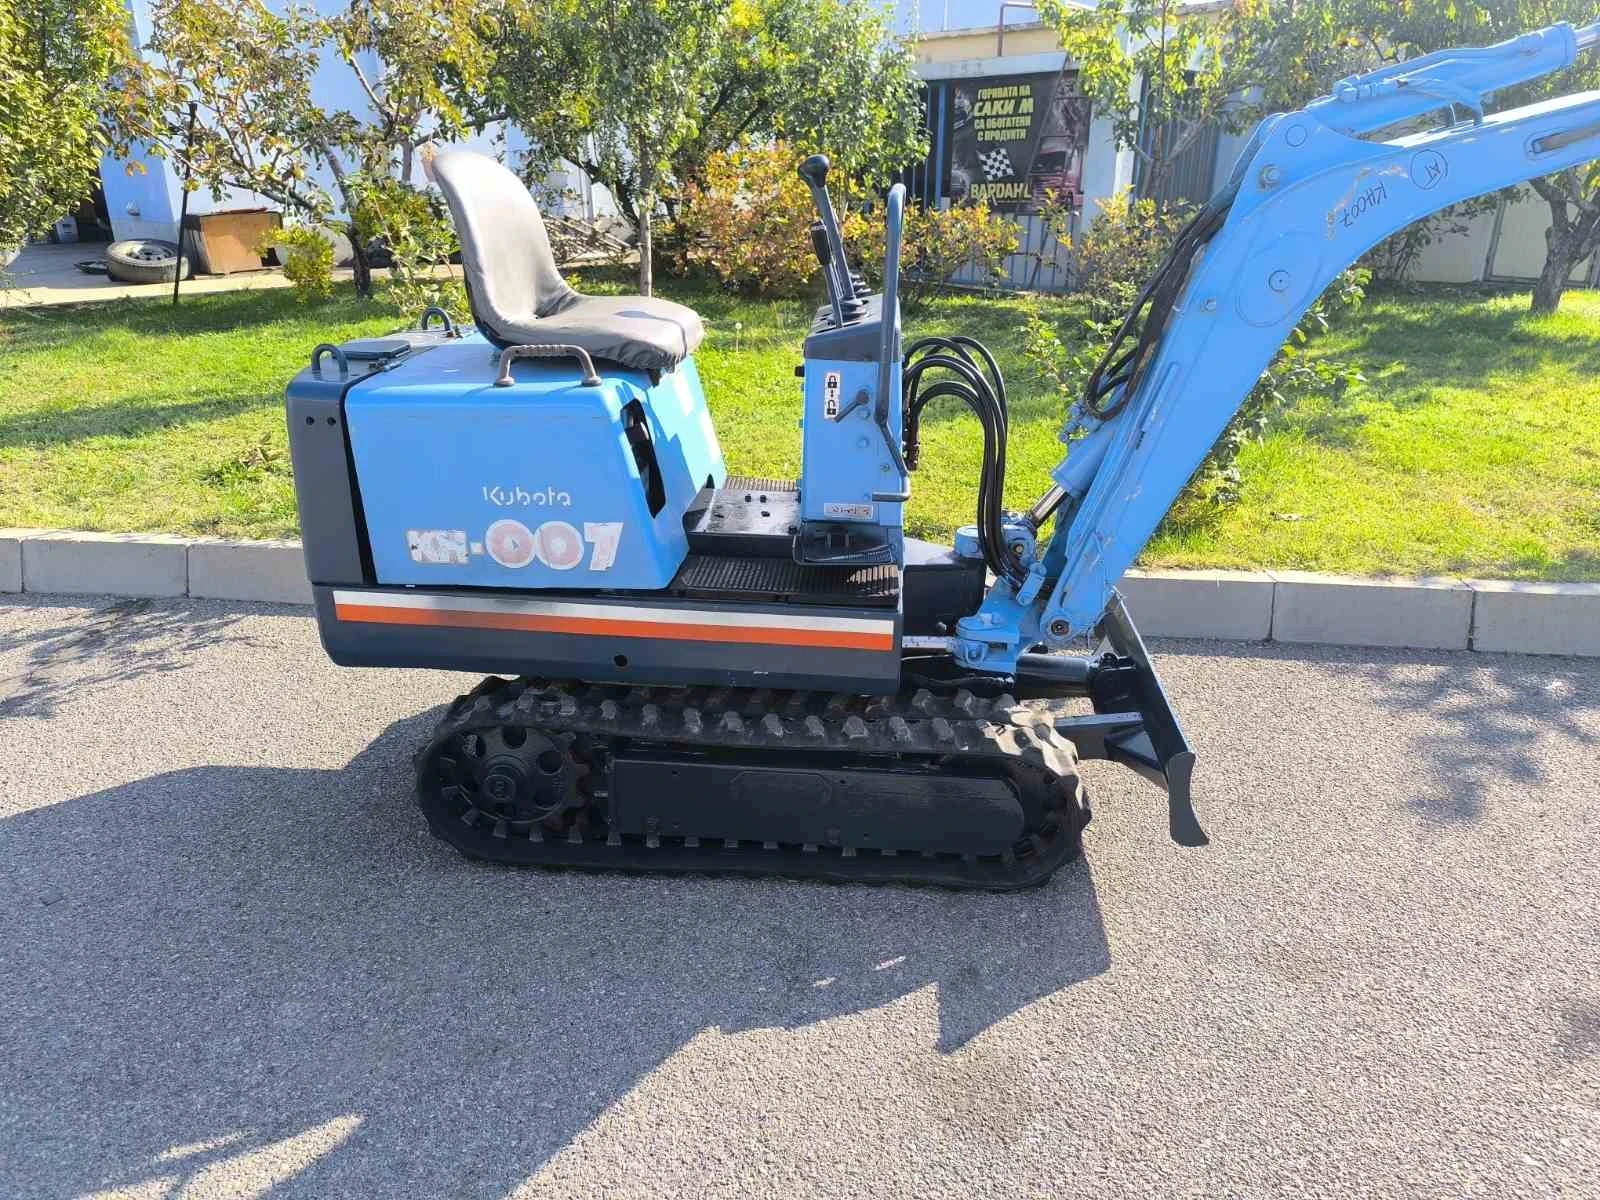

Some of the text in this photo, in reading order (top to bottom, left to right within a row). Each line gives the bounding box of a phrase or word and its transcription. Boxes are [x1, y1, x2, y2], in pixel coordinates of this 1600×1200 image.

[974, 98, 1034, 116] САКИ М
[970, 184, 1032, 204] BARDAHL
[482, 486, 571, 507] Kubota
